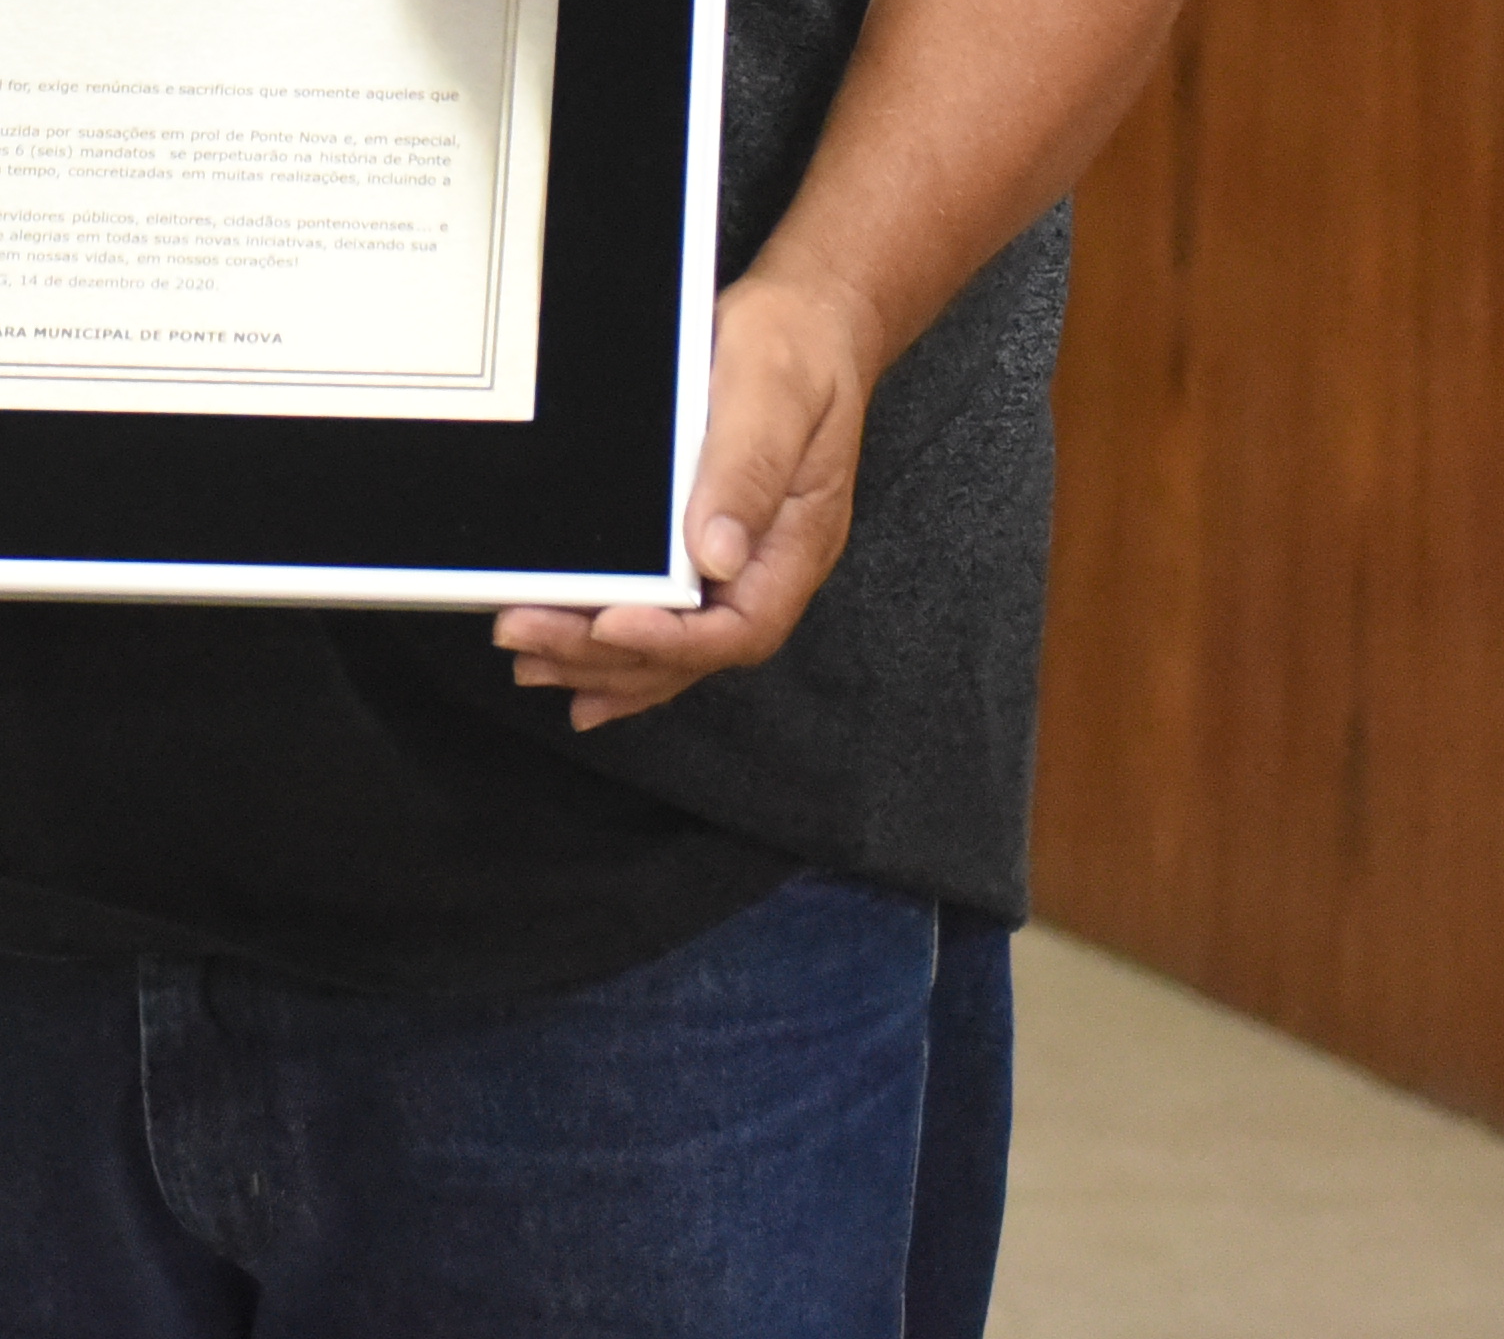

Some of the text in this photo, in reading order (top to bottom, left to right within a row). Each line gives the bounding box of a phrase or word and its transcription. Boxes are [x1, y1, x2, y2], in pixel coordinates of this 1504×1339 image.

[7, 78, 31, 95] for,
[37, 79, 79, 96] exige
[85, 79, 161, 95] renúncias
[164, 84, 175, 95] e
[258, 87, 288, 99] que
[293, 87, 361, 100] somente
[365, 87, 425, 102] aqueles
[430, 89, 460, 103] que
[45, 127, 72, 140] por
[160, 129, 185, 141] em
[190, 128, 221, 144] prol
[225, 129, 245, 142] de
[250, 129, 294, 144] Ponte
[299, 130, 338, 145] Nova
[363, 134, 388, 146] em
[393, 133, 461, 150] especial,
[14, 143, 25, 157] 6
[30, 144, 73, 160] (seis)
[79, 146, 156, 160] mandatos
[169, 149, 187, 160] se
[192, 149, 288, 163] perpetuarão
[293, 152, 312, 164] na
[382, 152, 402, 166] de
[407, 152, 452, 168] Ponte
[7, 163, 60, 180] tempo,
[67, 166, 174, 180] concretizadas
[181, 169, 206, 180] em
[211, 169, 264, 182] muitas
[270, 170, 360, 187] realizações,
[367, 172, 437, 187] incluindo
[442, 175, 452, 187] a
[71, 209, 139, 227] públicos,
[145, 212, 217, 229] eleitores,
[223, 214, 292, 229] cidadãos
[439, 221, 449, 233] e
[9, 228, 70, 245] alegrias
[76, 232, 101, 244] em
[105, 231, 149, 245] todas
[153, 234, 189, 246] suas
[194, 234, 241, 247] novas
[245, 235, 327, 251] iniciativas,
[333, 236, 405, 251] deixando
[410, 241, 438, 252] sua
[26, 251, 79, 263] nossas
[136, 253, 161, 265] em
[166, 254, 220, 267] nossos
[21, 273, 38, 287] 14
[43, 274, 63, 288] de
[67, 275, 145, 290] dezembro
[150, 277, 170, 290] de
[33, 326, 132, 340] MUNICIPAL
[139, 329, 160, 341] DE
[168, 329, 226, 343] PONTE
[233, 331, 282, 344] NOVA
